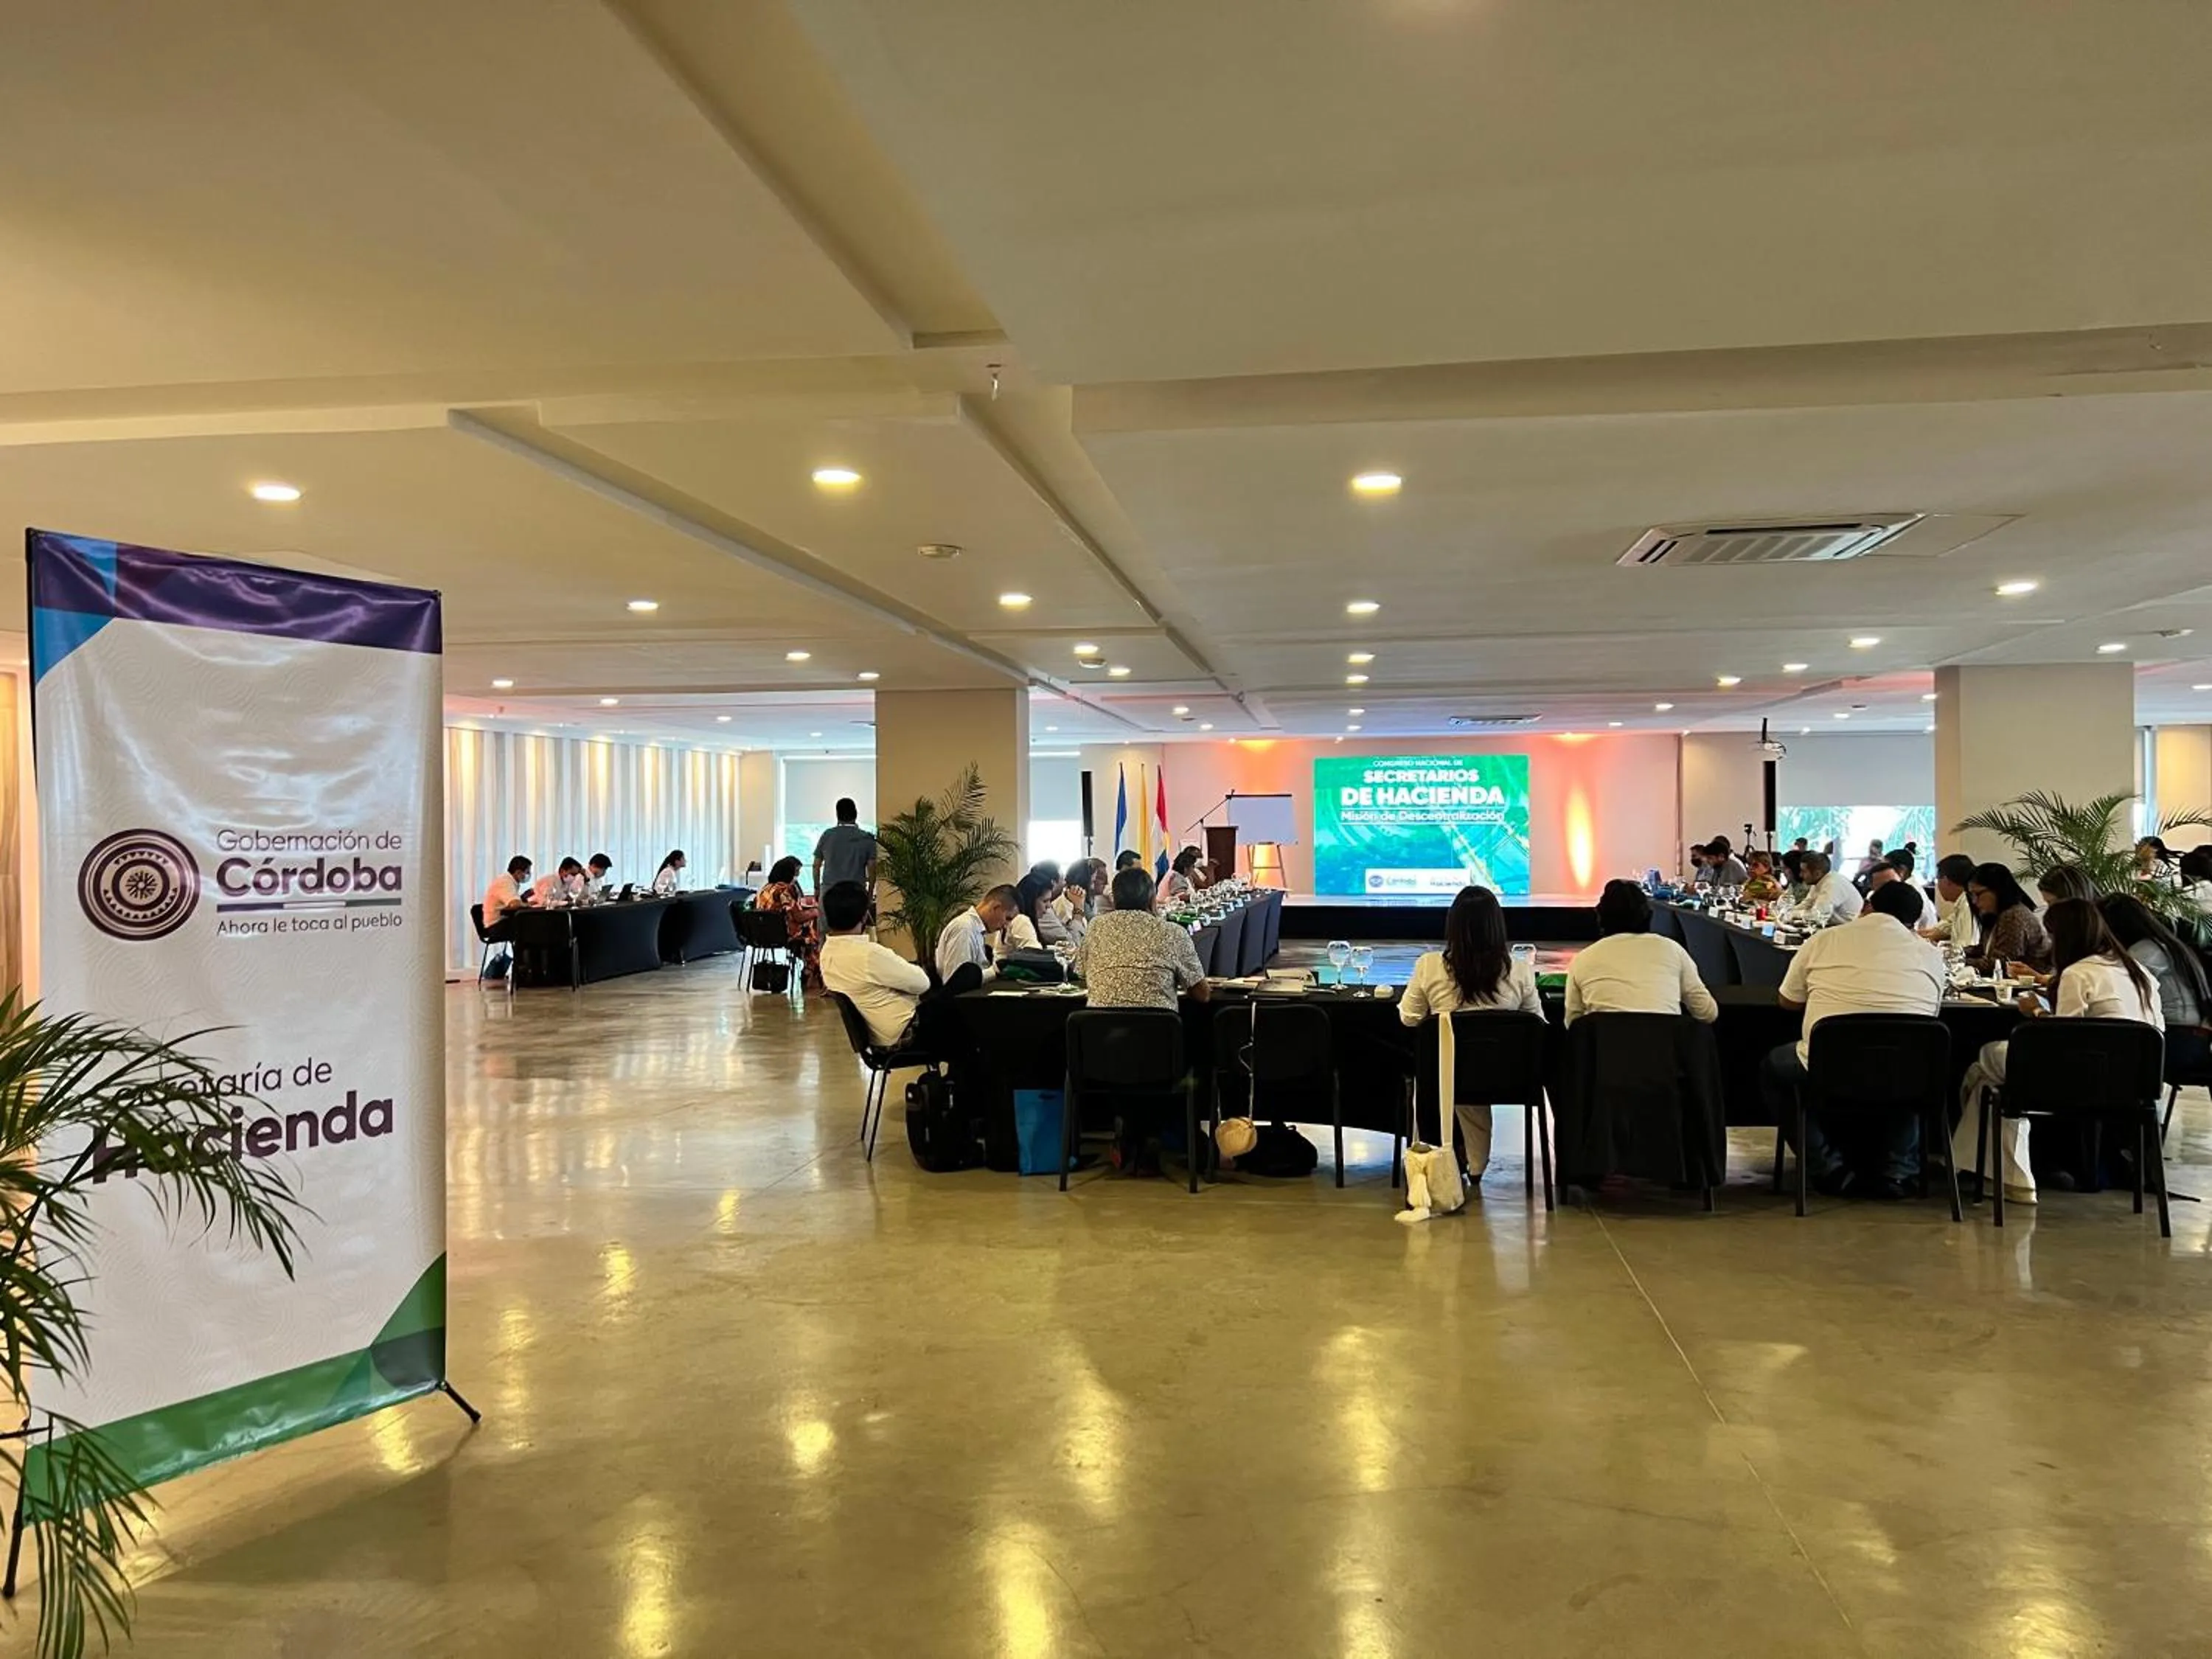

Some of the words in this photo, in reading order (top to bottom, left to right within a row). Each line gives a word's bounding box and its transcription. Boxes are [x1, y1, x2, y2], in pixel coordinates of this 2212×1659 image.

[1363, 769, 1479, 783] SECRETARIOS
[1340, 787, 1372, 805] DE
[1377, 786, 1505, 805] HACIENDA
[1340, 810, 1377, 821] Misión
[1380, 811, 1396, 821] de
[216, 829, 369, 852] Gobernación
[375, 829, 403, 850] de
[216, 857, 403, 897] Córdoba
[216, 919, 268, 936] Ahora
[273, 917, 288, 933] le
[291, 917, 330, 932] toca
[333, 914, 348, 930] al
[351, 913, 403, 933] pueblo
[94, 1061, 282, 1110] retaría
[293, 1057, 333, 1087] de
[92, 1091, 394, 1185] Hcienda
